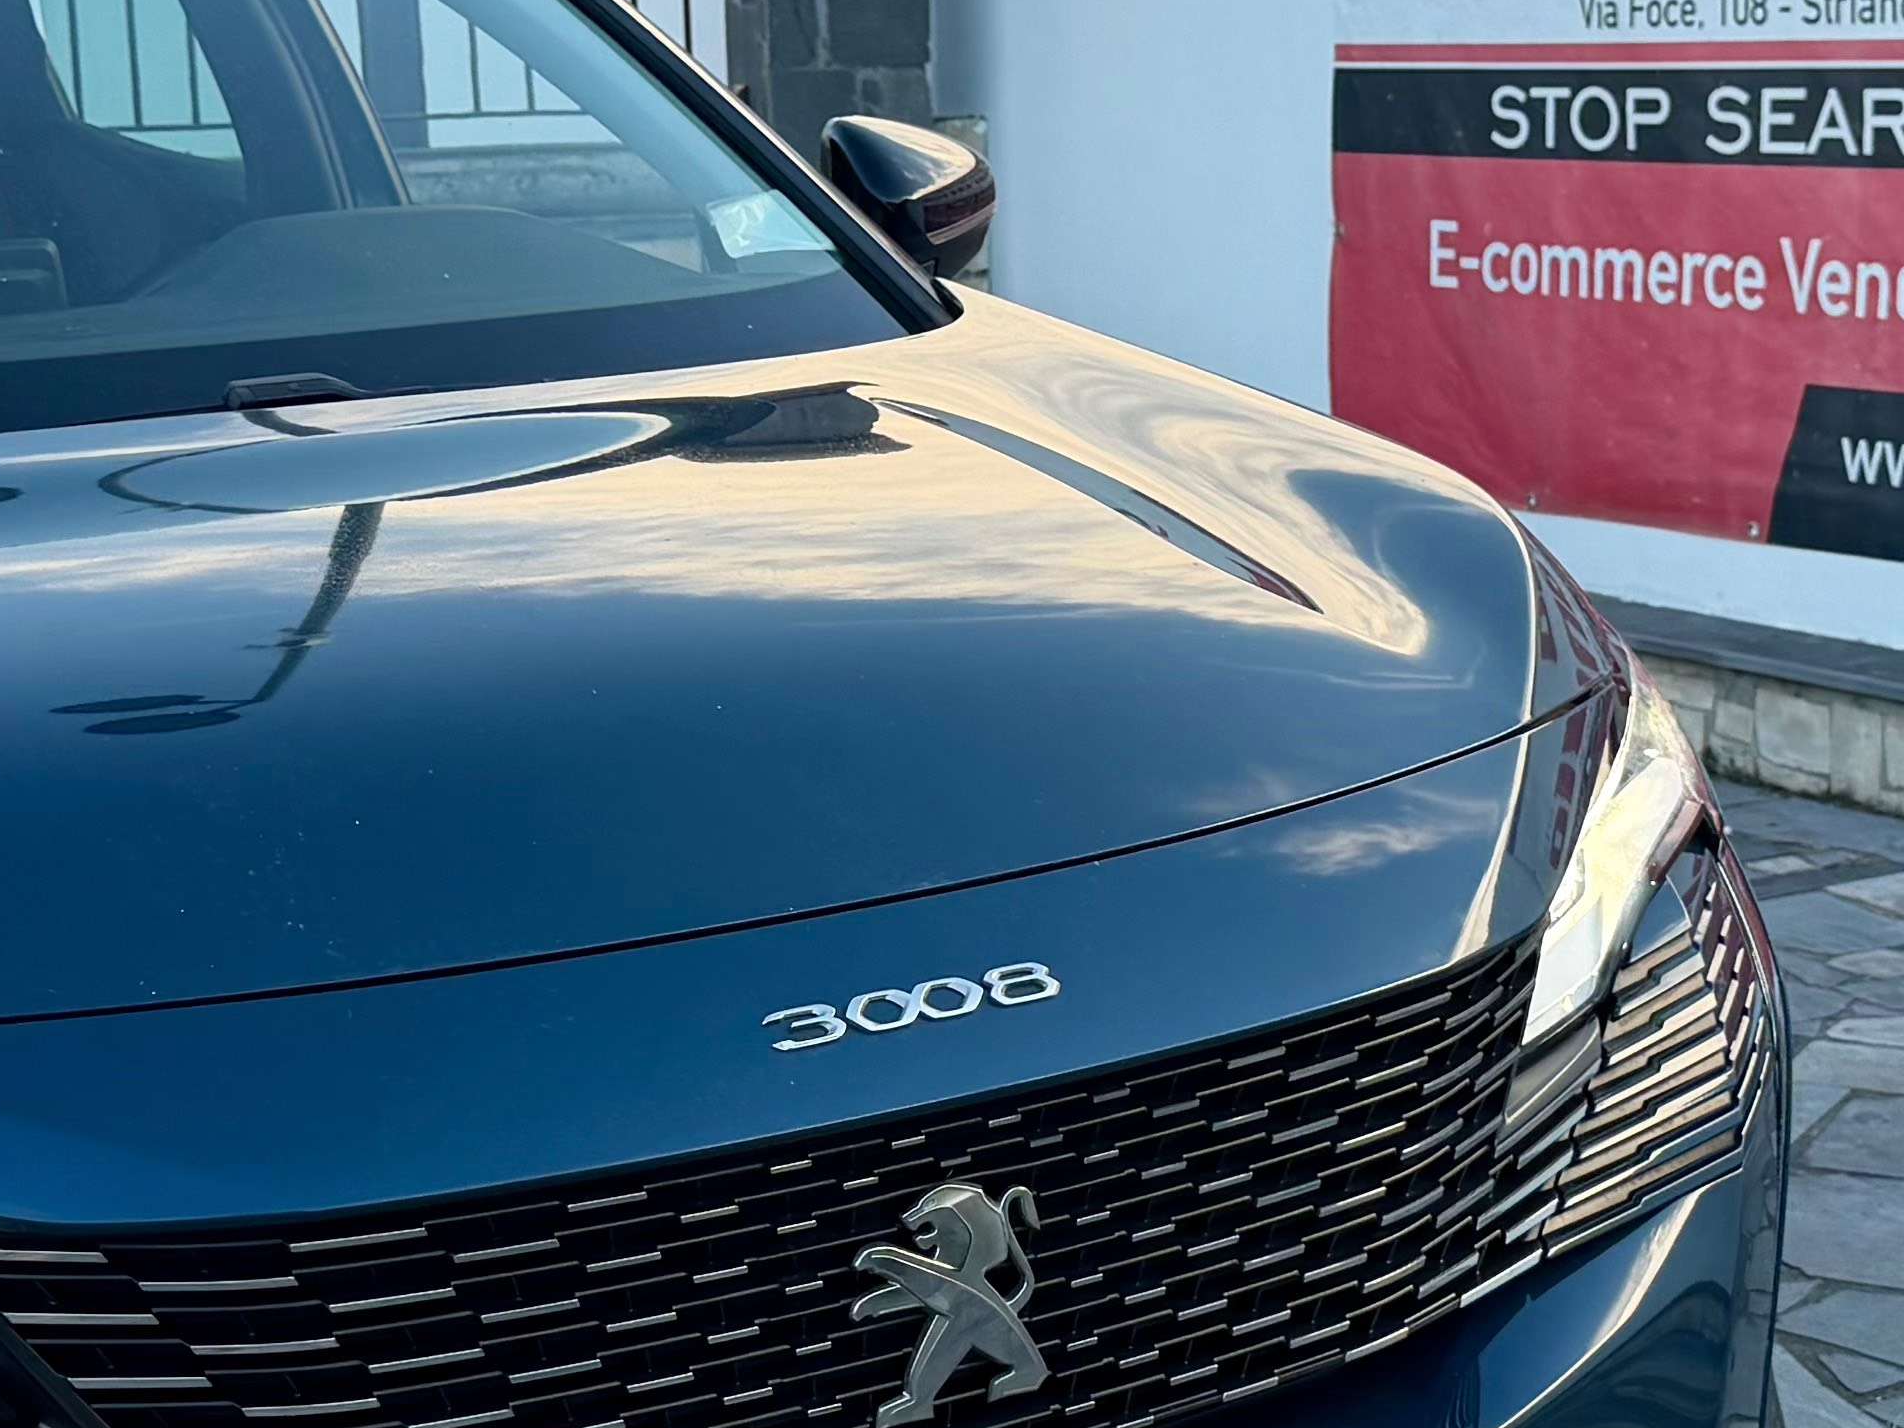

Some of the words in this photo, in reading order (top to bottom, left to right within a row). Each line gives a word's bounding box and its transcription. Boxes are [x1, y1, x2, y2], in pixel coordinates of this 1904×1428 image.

[1490, 84, 1672, 152] STOP
[1428, 218, 1767, 312] E-commerce
[761, 961, 1062, 1053] 3008
